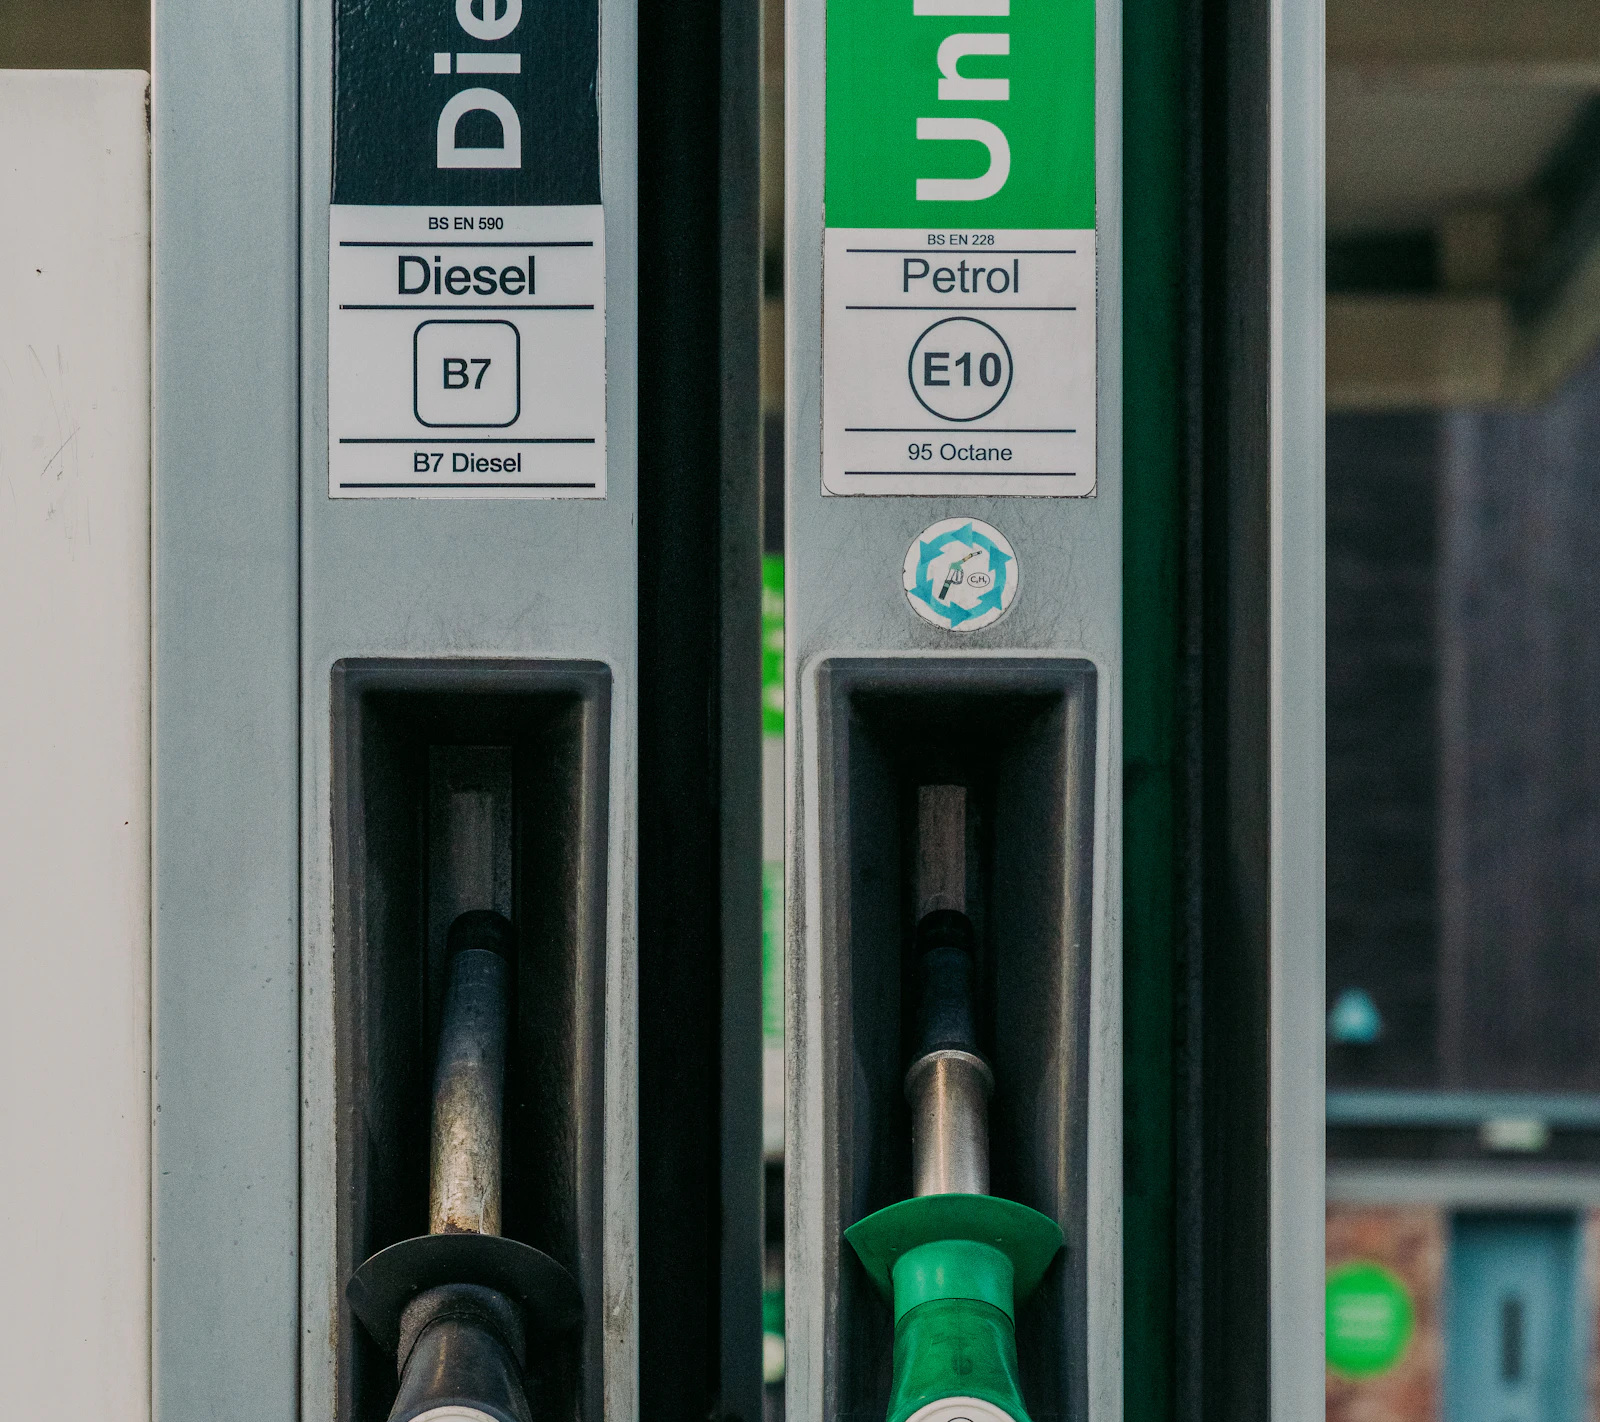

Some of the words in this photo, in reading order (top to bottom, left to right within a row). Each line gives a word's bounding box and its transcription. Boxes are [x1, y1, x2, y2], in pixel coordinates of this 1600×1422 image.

[428, 217, 449, 230] BS
[454, 217, 474, 230] EN
[479, 217, 503, 230] 590
[927, 234, 946, 246] BS
[950, 234, 968, 246] EN
[972, 234, 995, 246] 228
[398, 255, 536, 296] Diesel
[903, 258, 1019, 294] Petrol
[443, 358, 492, 389] B7
[923, 352, 1002, 387] E10
[413, 452, 444, 473] B7
[452, 452, 522, 473] Diesel
[908, 443, 933, 461] 95
[940, 443, 1013, 461] Octane
